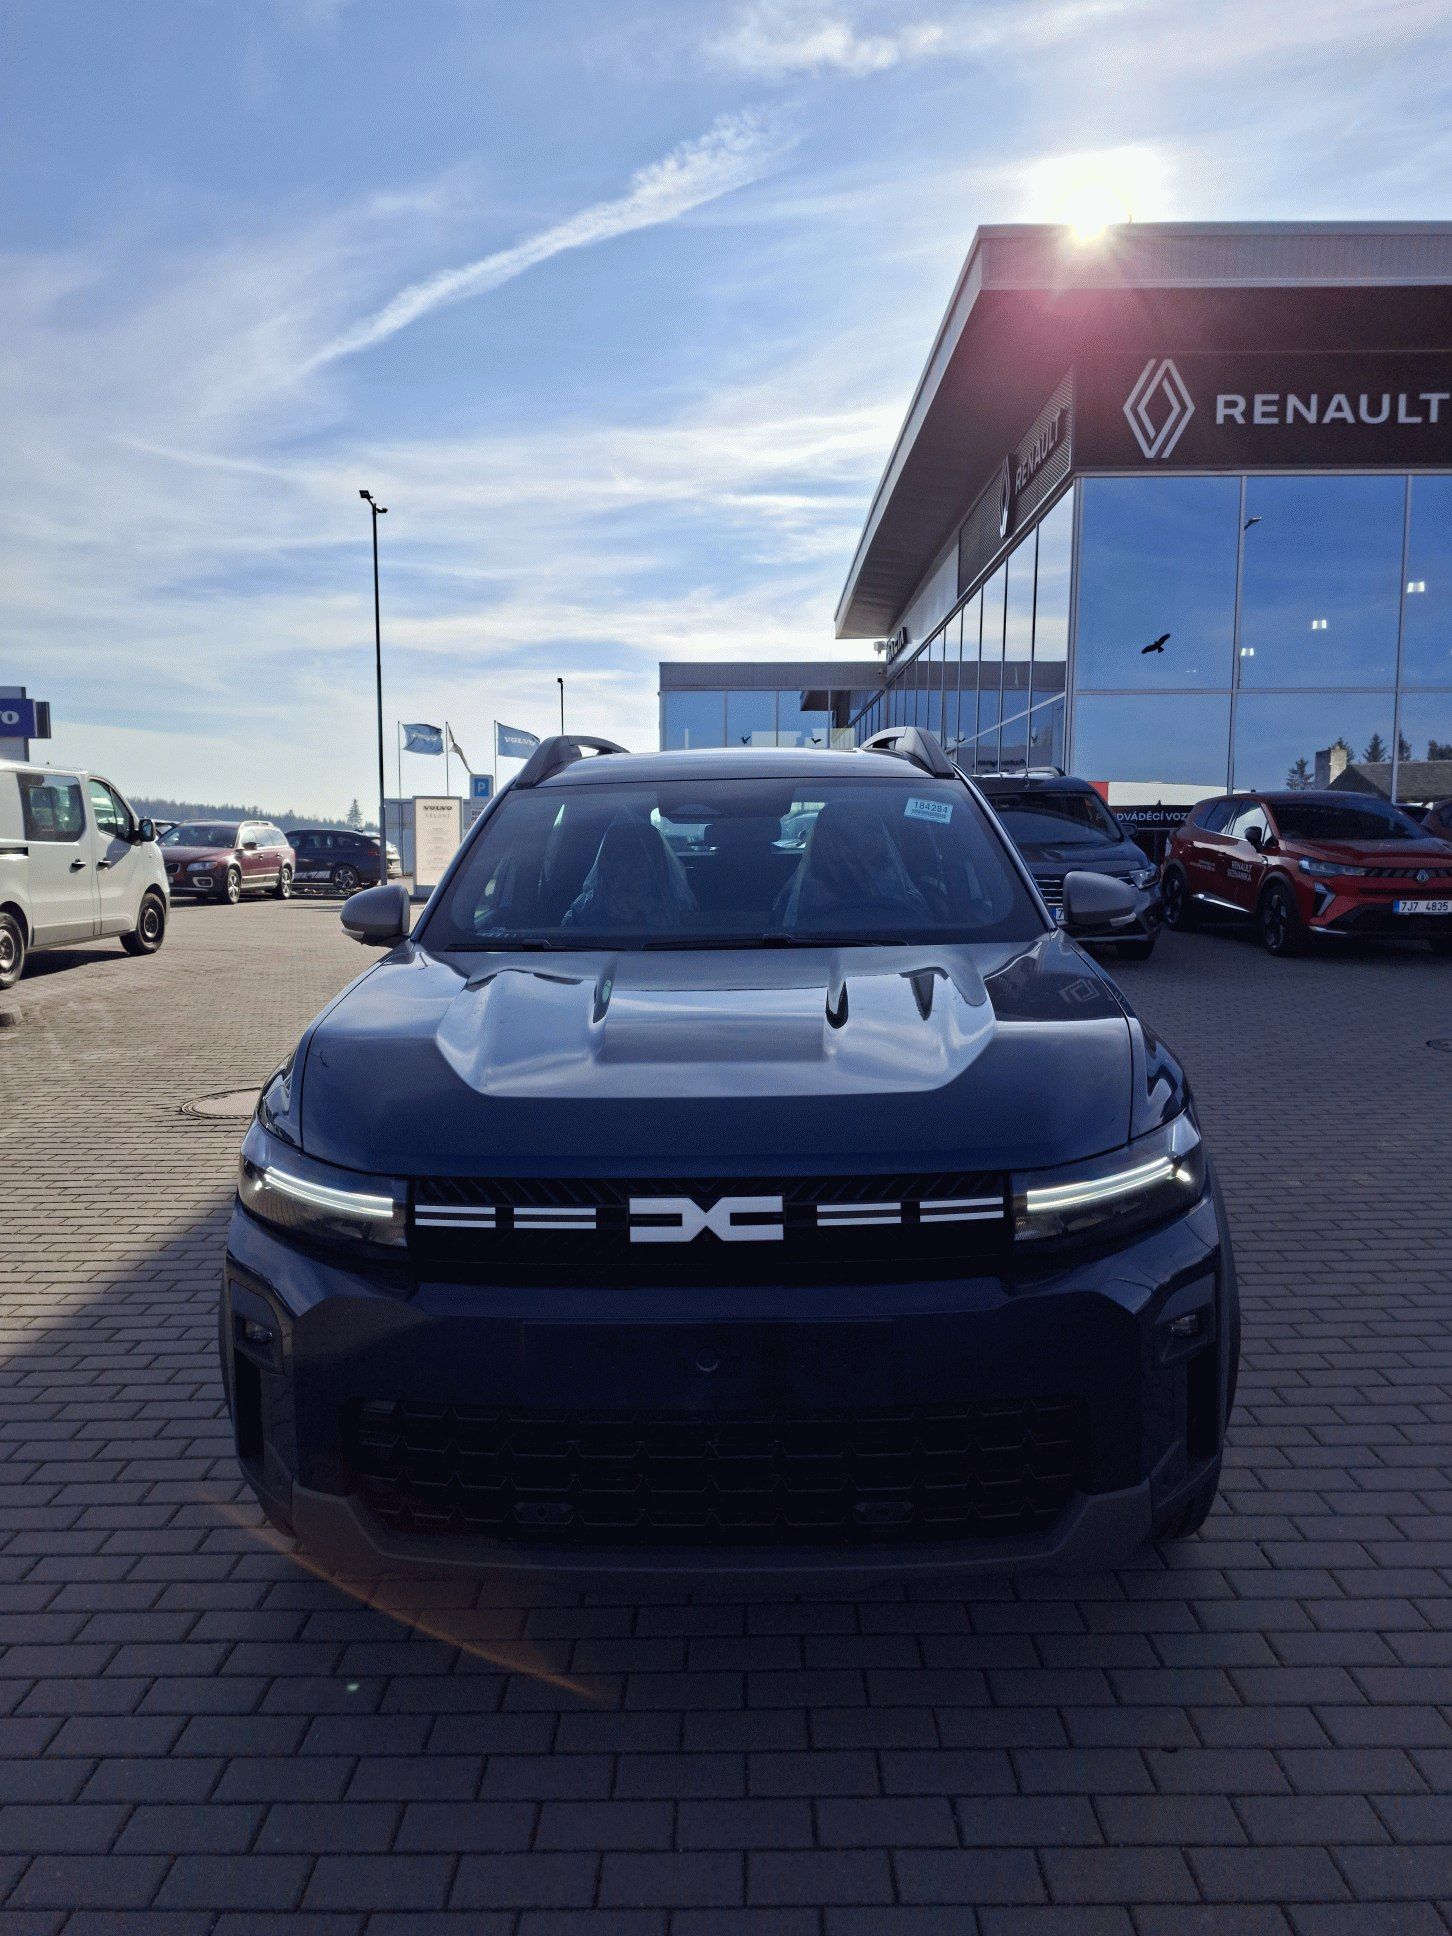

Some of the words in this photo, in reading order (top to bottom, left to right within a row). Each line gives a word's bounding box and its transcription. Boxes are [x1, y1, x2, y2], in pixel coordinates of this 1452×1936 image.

[1216, 393, 1450, 424] RENAULT
[1015, 409, 1060, 495] RENAULT
[503, 736, 536, 747] VOLVO
[477, 783, 486, 793] P
[914, 801, 948, 813] 184284
[1401, 901, 1419, 911] 7J7
[1425, 901, 1449, 911] 4835
